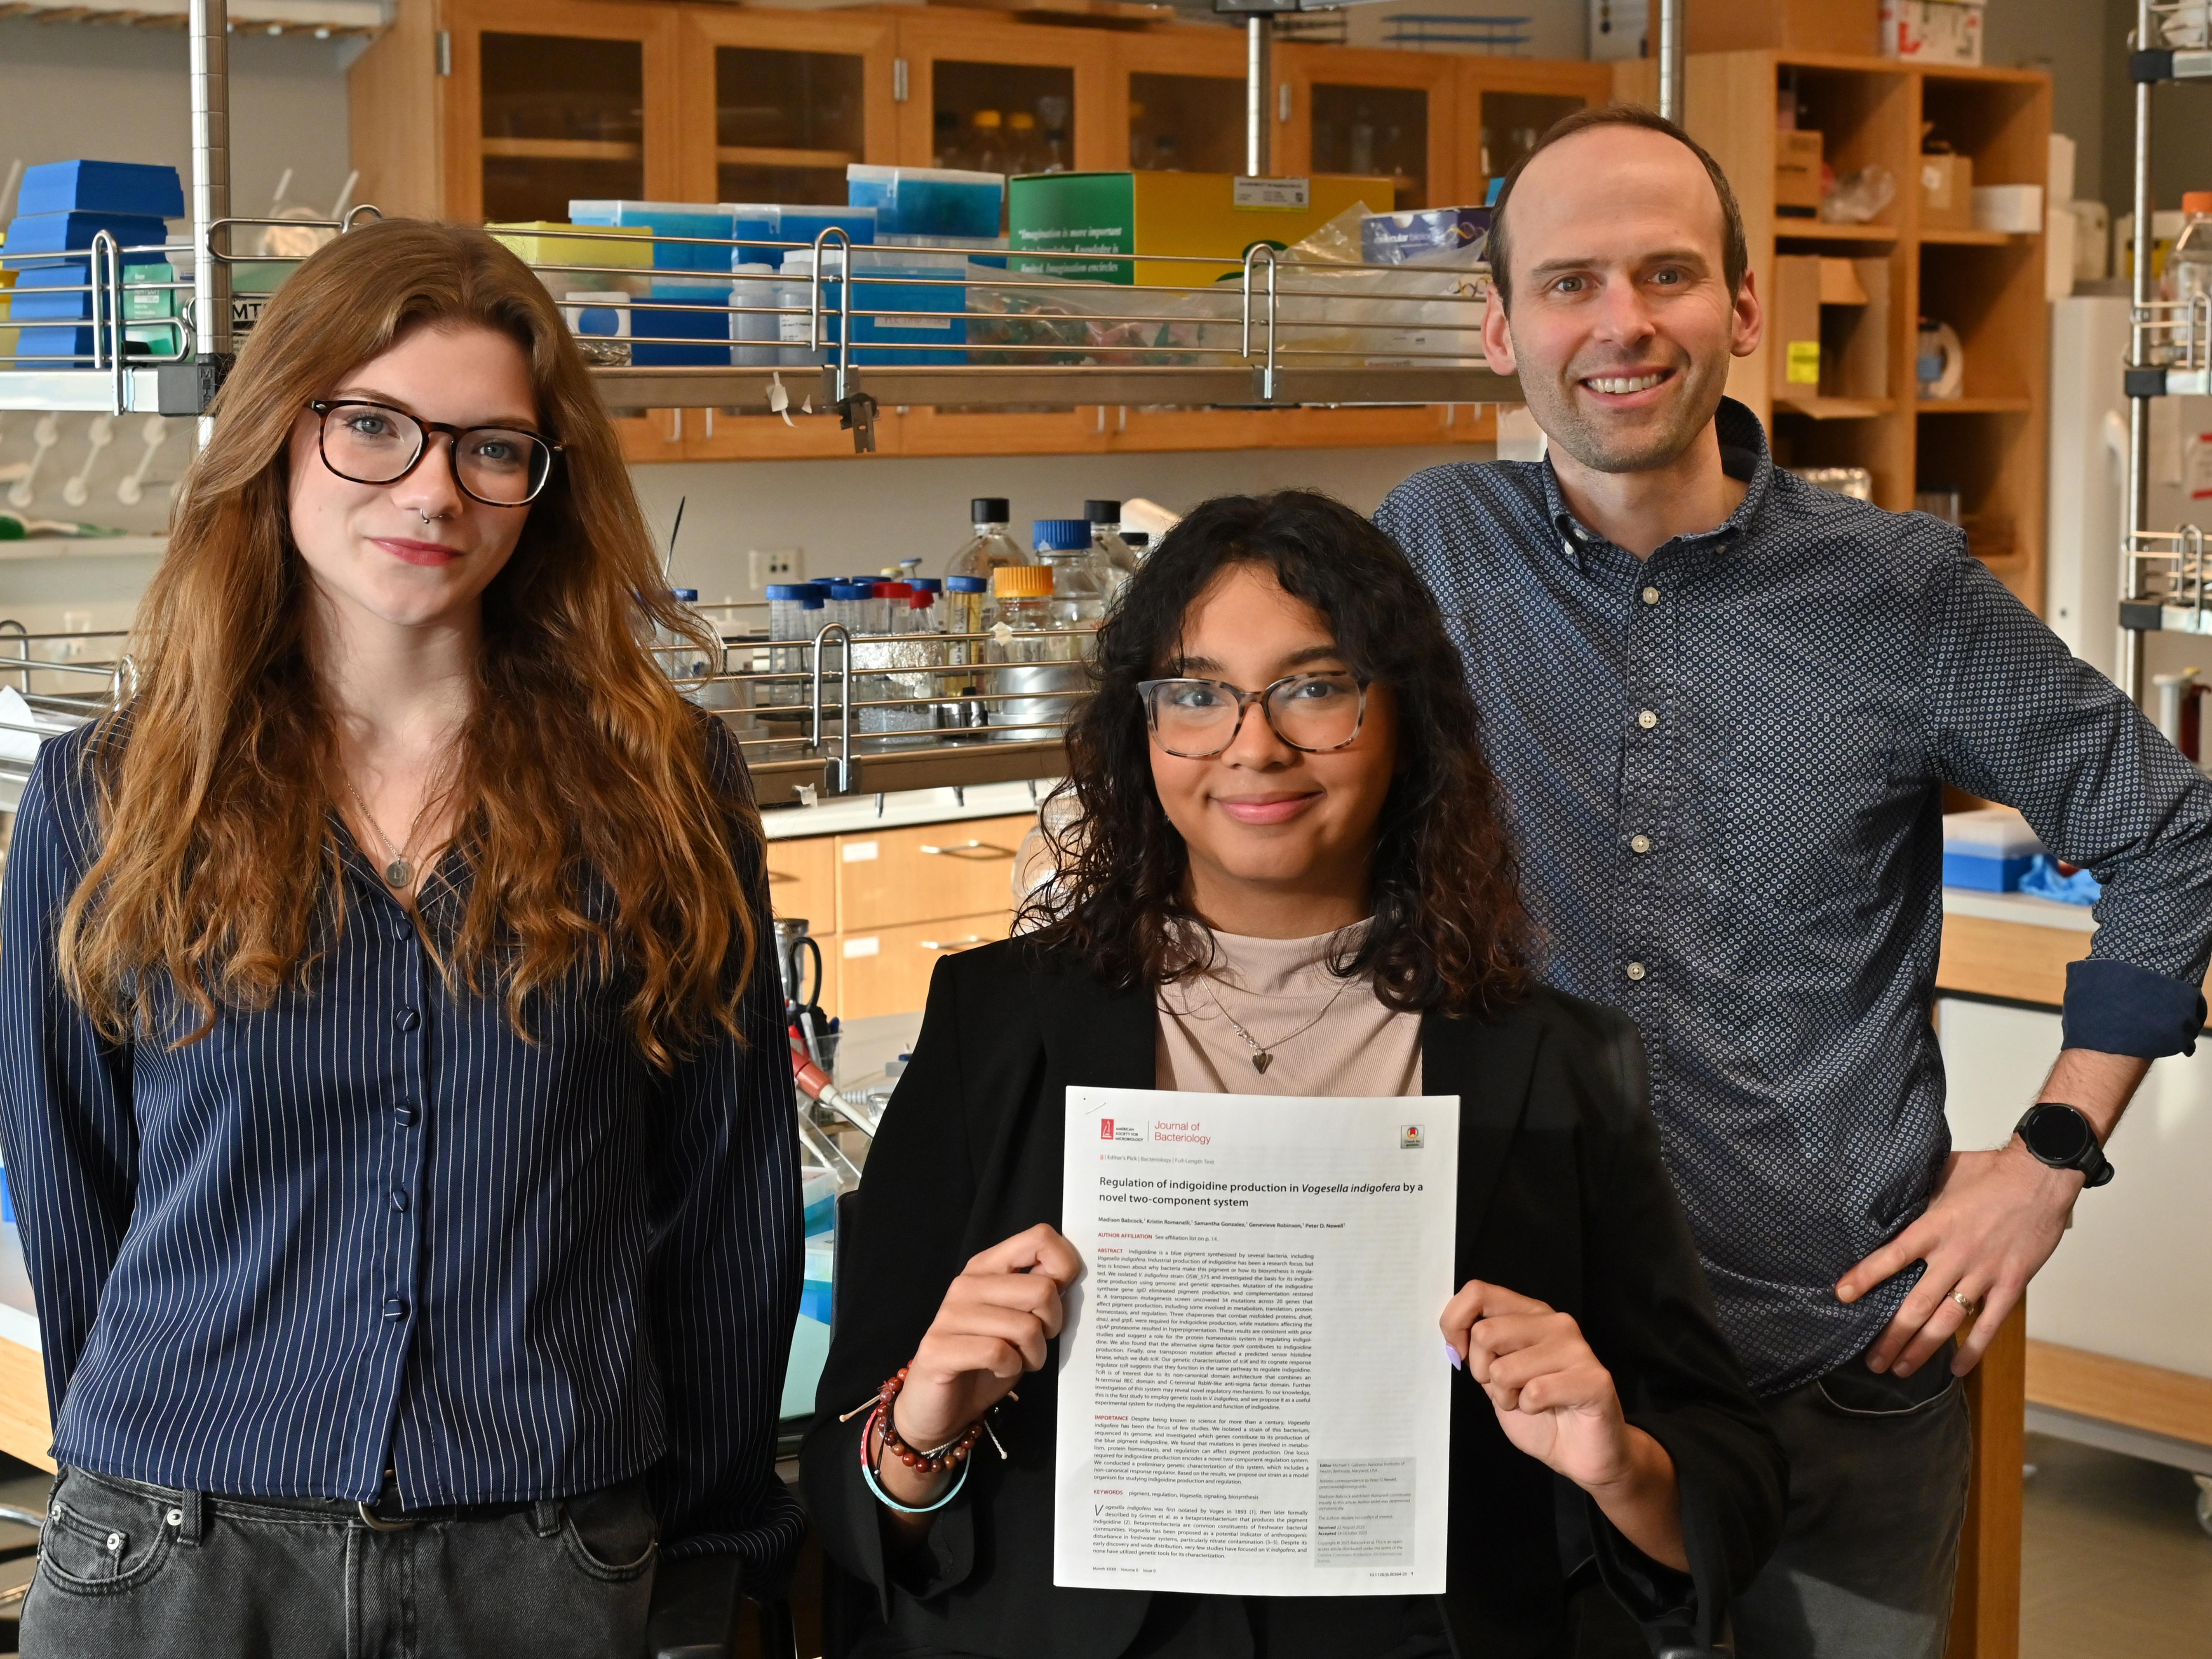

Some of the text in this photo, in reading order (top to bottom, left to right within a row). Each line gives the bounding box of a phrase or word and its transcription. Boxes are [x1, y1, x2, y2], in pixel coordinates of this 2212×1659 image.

[1155, 1121, 1200, 1131] Journal of
[1155, 1132, 1211, 1145] Bacteriology
[1100, 1177, 1153, 1188] Regulation
[1157, 1179, 1167, 1188] of
[1169, 1180, 1227, 1191] indigoidine
[1230, 1183, 1286, 1192] production
[1289, 1184, 1299, 1192] in
[1302, 1184, 1348, 1195] Vogesella
[1350, 1183, 1400, 1194] indigofera
[1403, 1182, 1415, 1193] by
[1099, 1193, 1248, 1208] novel two-component system
